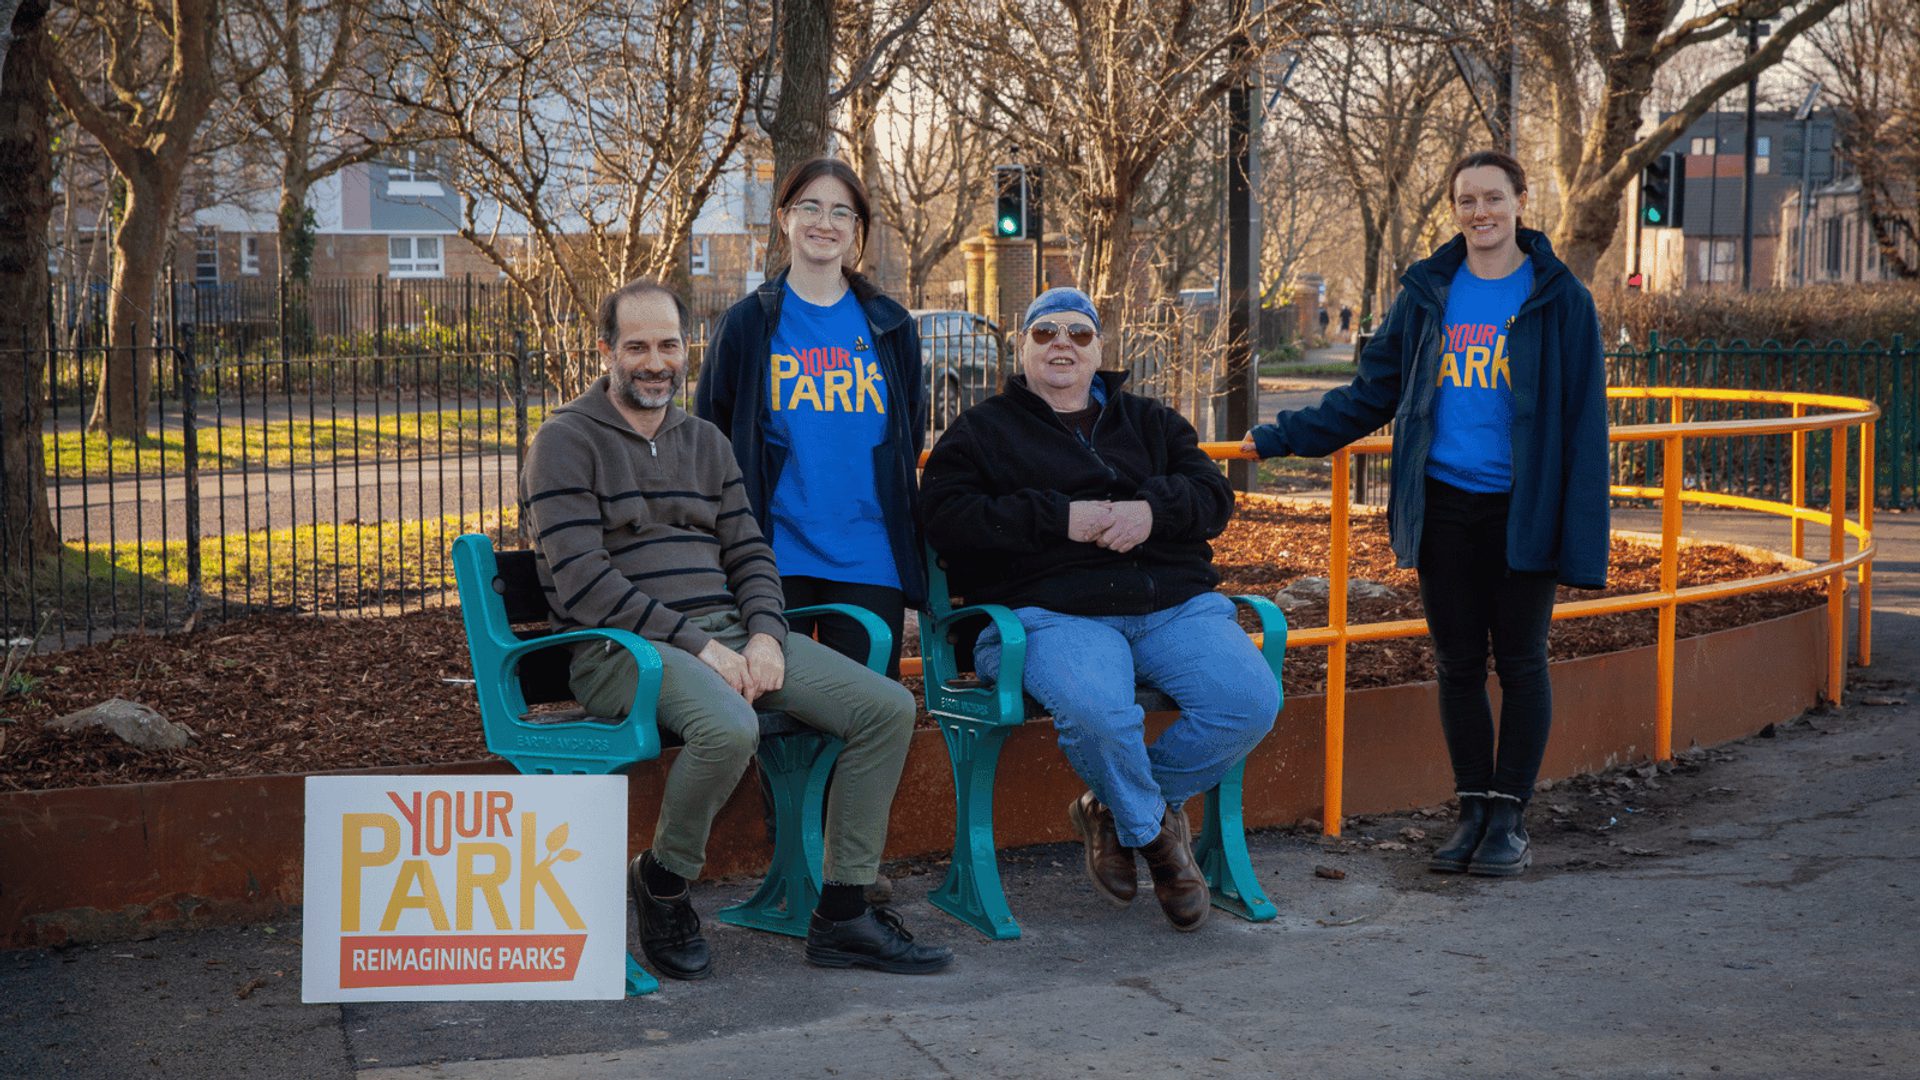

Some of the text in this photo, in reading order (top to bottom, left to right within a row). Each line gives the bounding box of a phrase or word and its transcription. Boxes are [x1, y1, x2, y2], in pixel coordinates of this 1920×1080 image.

[1446, 324, 1497, 352] YOUR
[791, 347, 851, 377] YOUR
[1437, 335, 1512, 390] ARK
[771, 354, 885, 413] PARK
[517, 735, 609, 752] EARTH ANCHORS
[386, 790, 514, 856] YOUR
[341, 812, 587, 931] PARK
[352, 946, 565, 971] REIMAGINING PARKS
